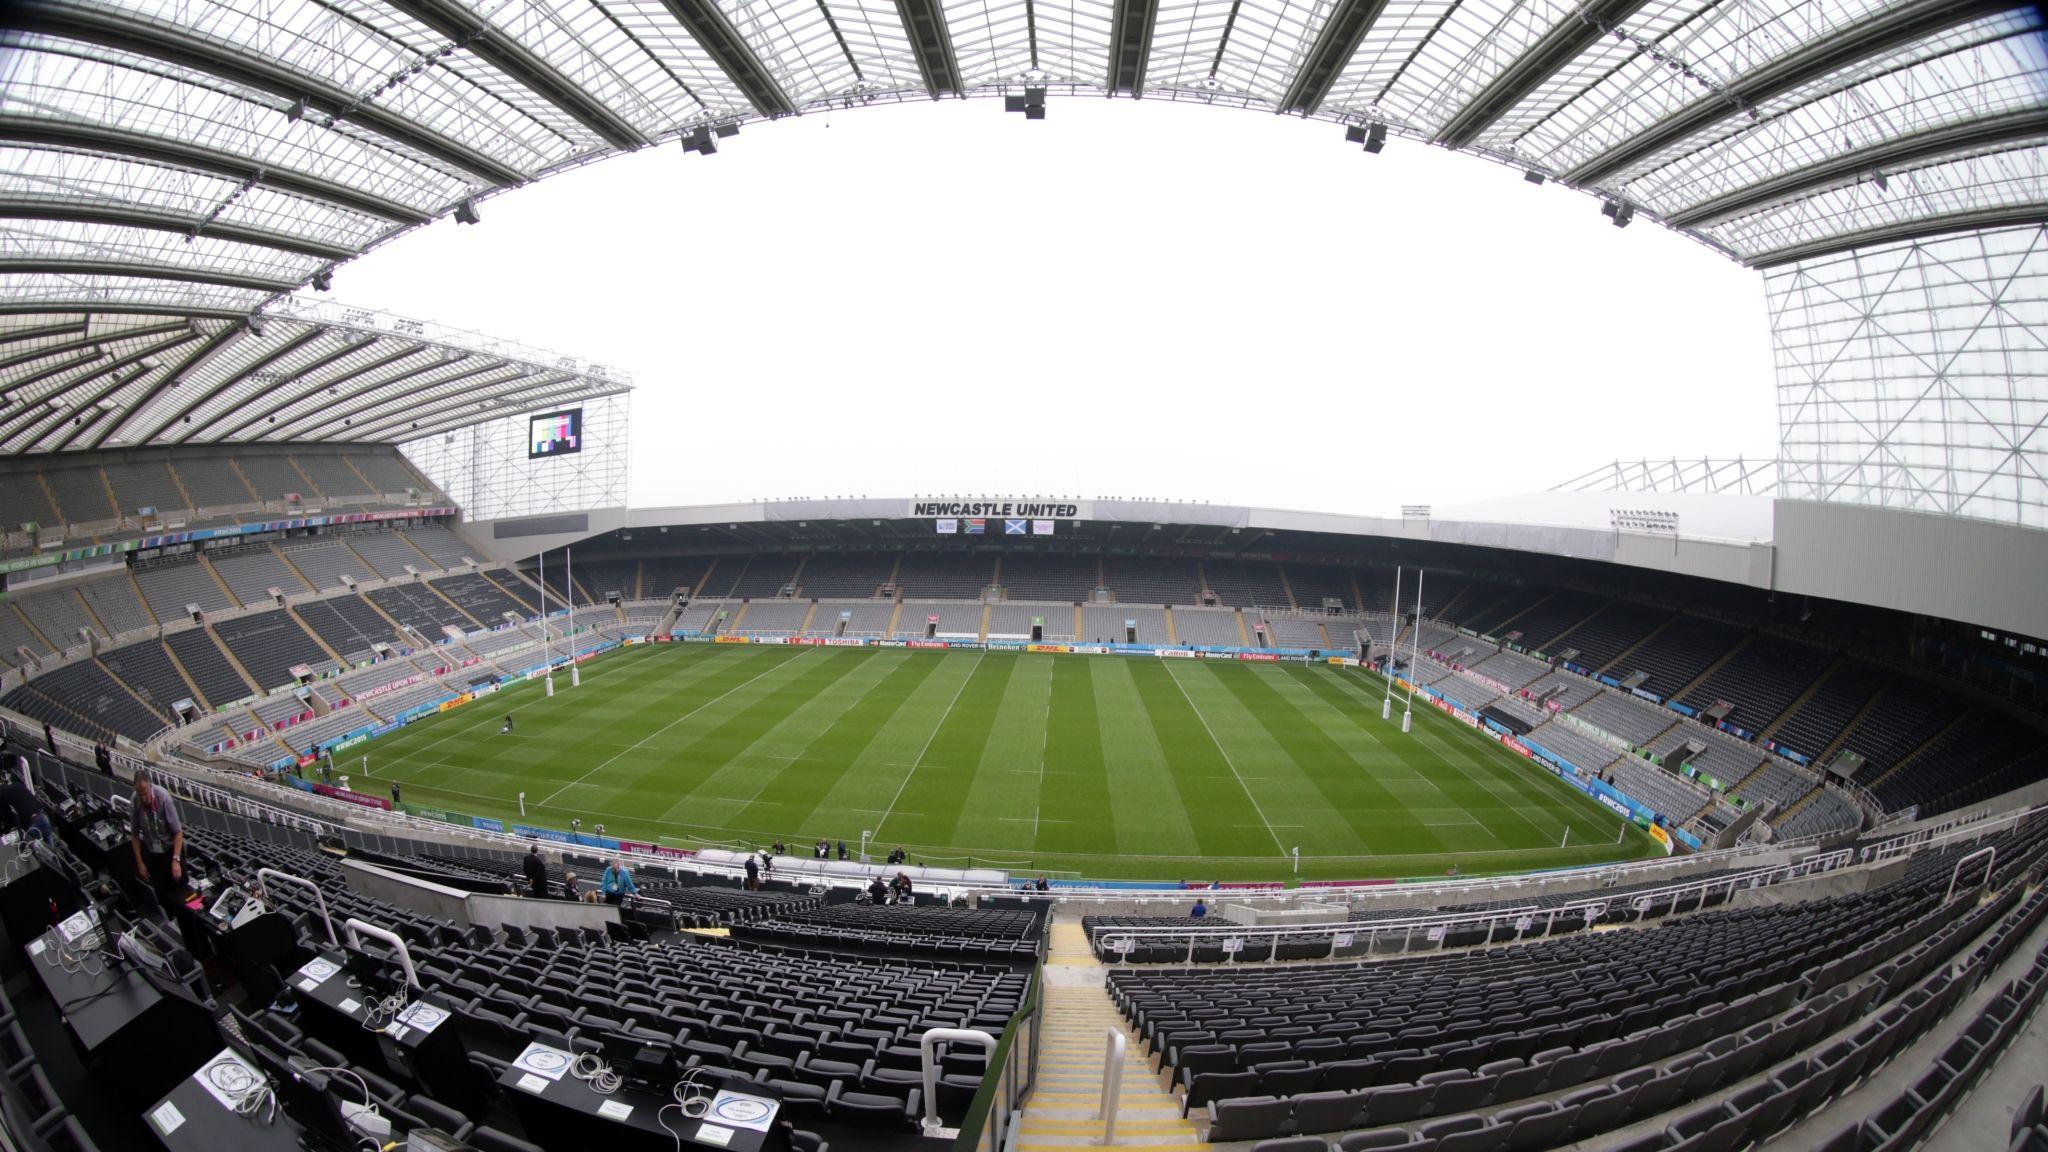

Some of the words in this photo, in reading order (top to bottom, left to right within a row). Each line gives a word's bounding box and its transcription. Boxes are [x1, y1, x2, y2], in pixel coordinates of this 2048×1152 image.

[914, 503, 1012, 516] NEWCASTLE
[1016, 503, 1077, 517] UNITED
[988, 643, 1020, 651] Heineken
[1243, 653, 1253, 661] Fly
[355, 684, 392, 701] NEWCASTLE
[392, 678, 409, 690] UPON
[447, 697, 465, 708] DHL
[1579, 720, 1600, 737] WORLD
[1607, 733, 1628, 749] UNION
[336, 733, 367, 752] #RWC2015
[1530, 751, 1542, 763] LAND
[1541, 757, 1556, 770] ROVER
[1598, 793, 1631, 818] #RWC2015
[482, 820, 504, 832] RUGBY
[1652, 828, 1664, 838] DHL
